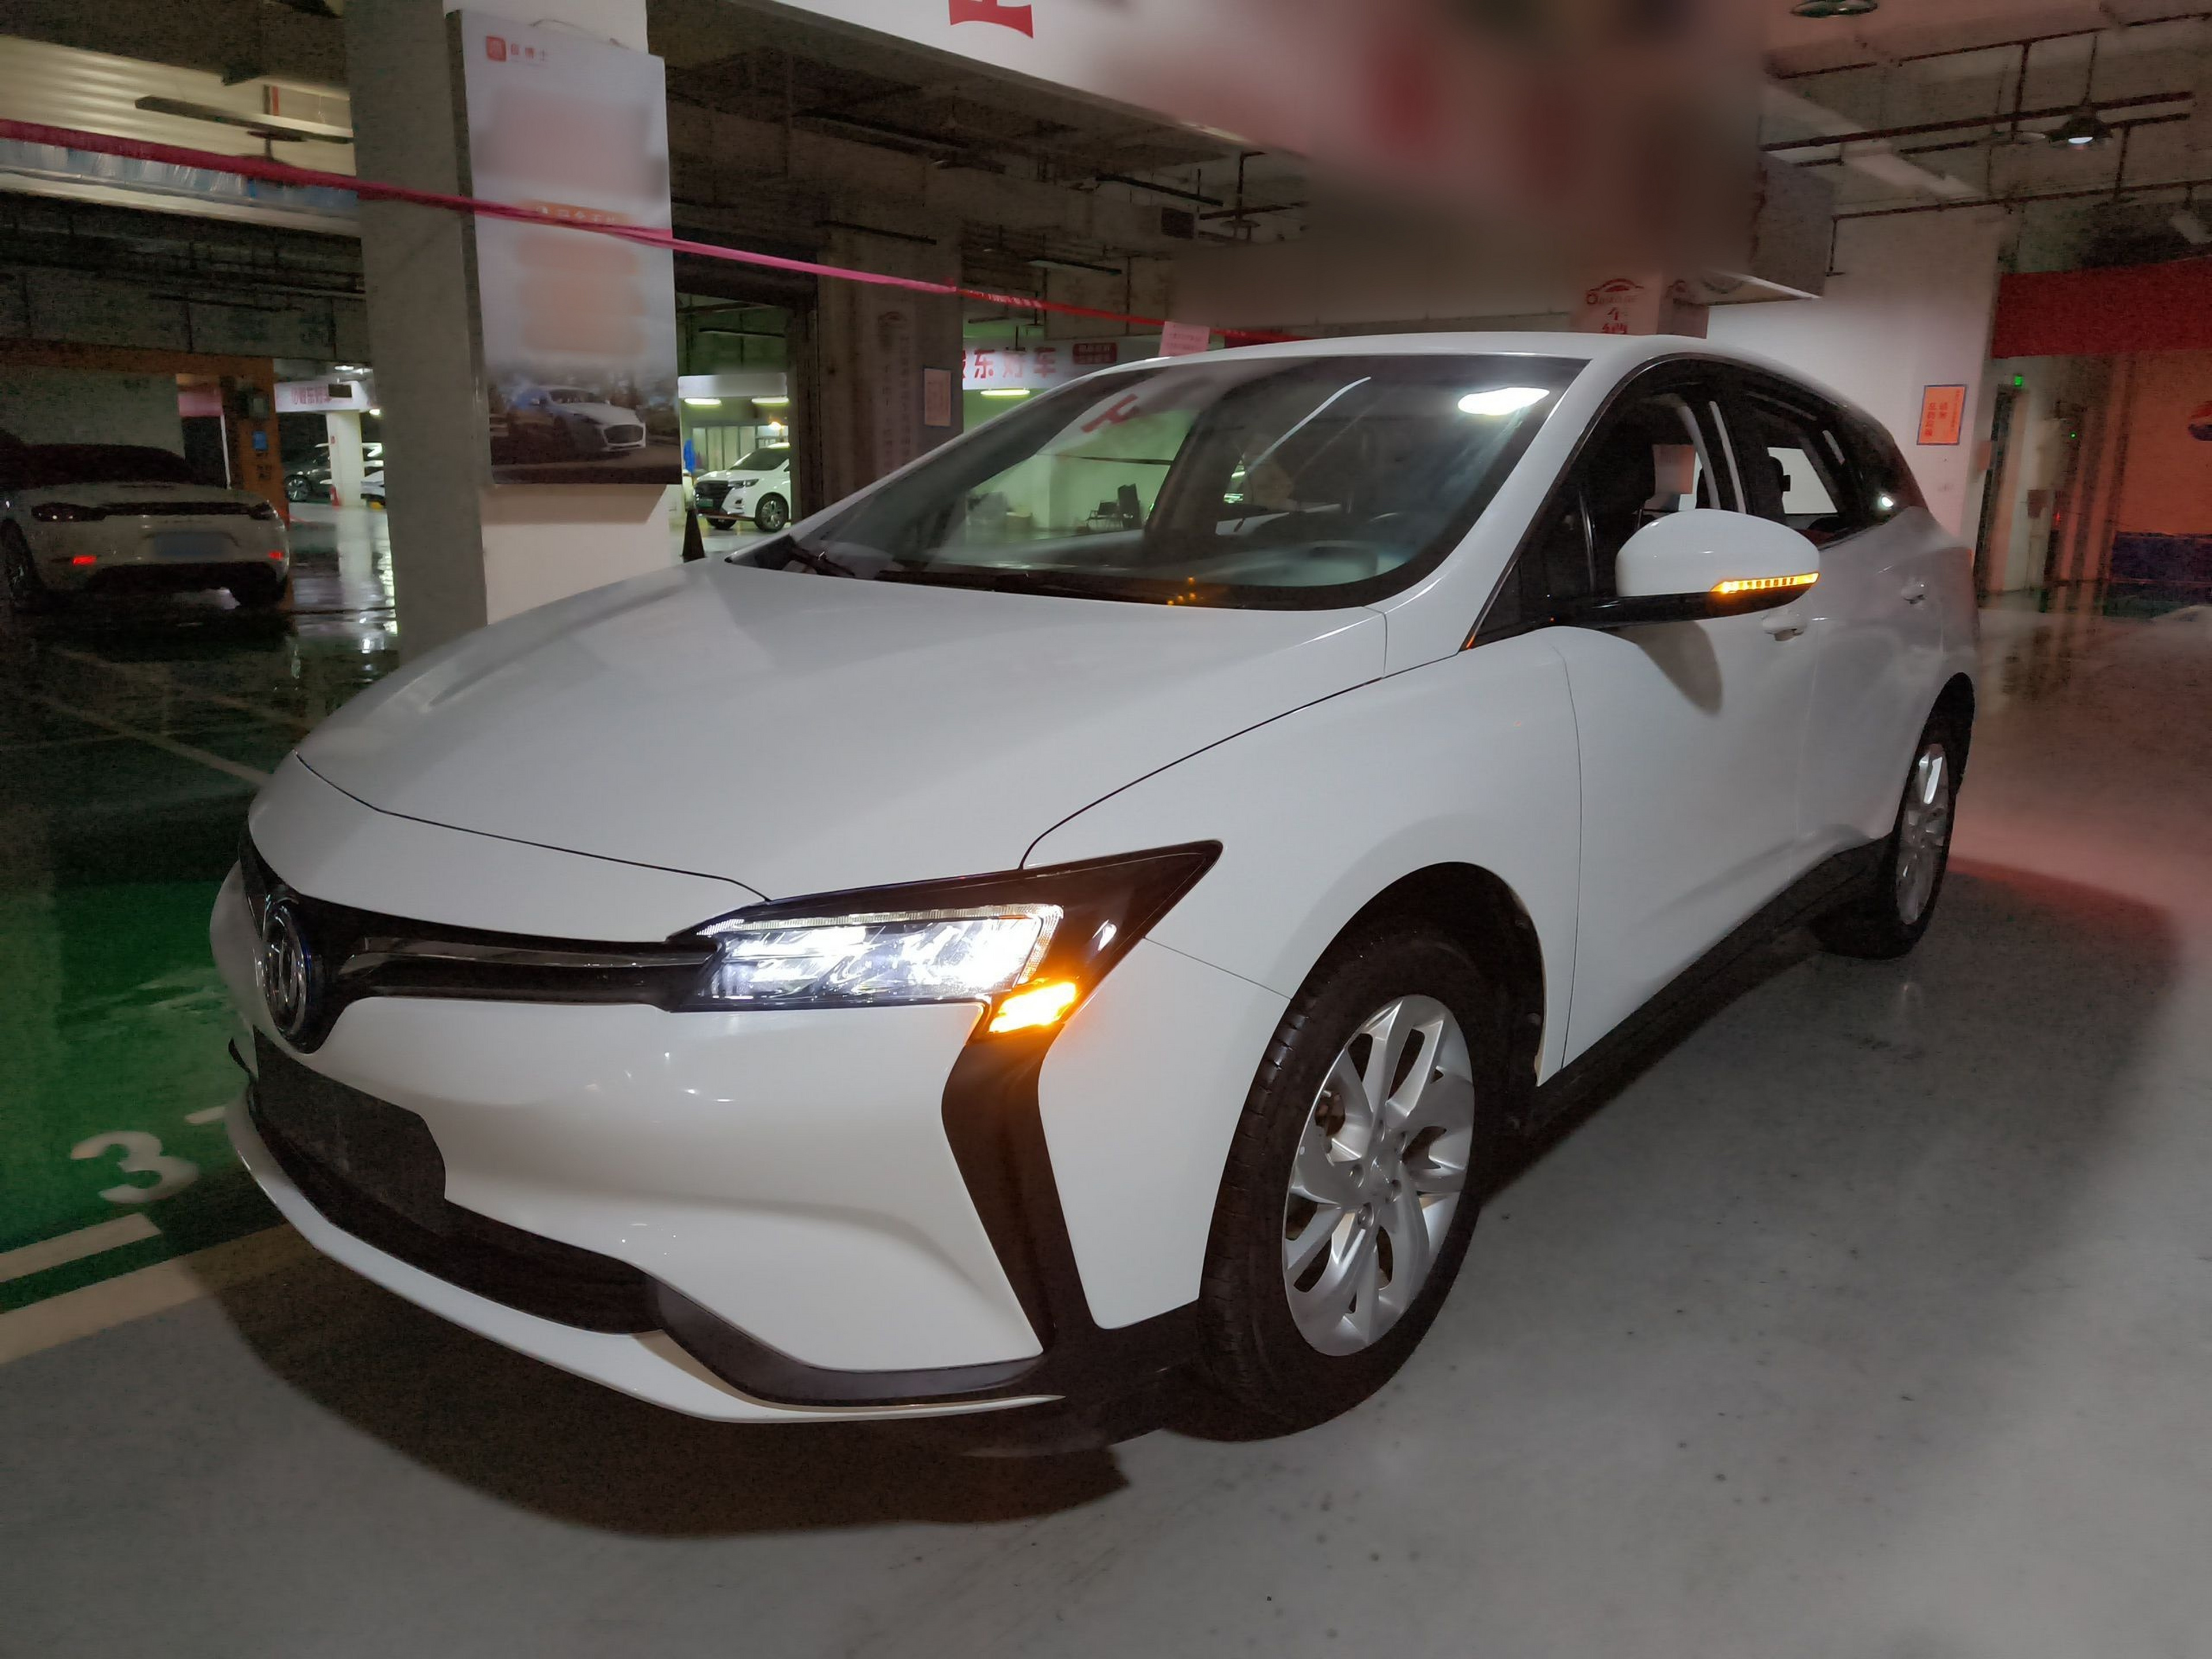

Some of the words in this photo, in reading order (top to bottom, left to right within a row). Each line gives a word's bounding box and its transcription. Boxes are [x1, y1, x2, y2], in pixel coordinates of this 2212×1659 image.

[963, 347, 1056, 378] 东好车
[70, 1107, 228, 1204] 3
